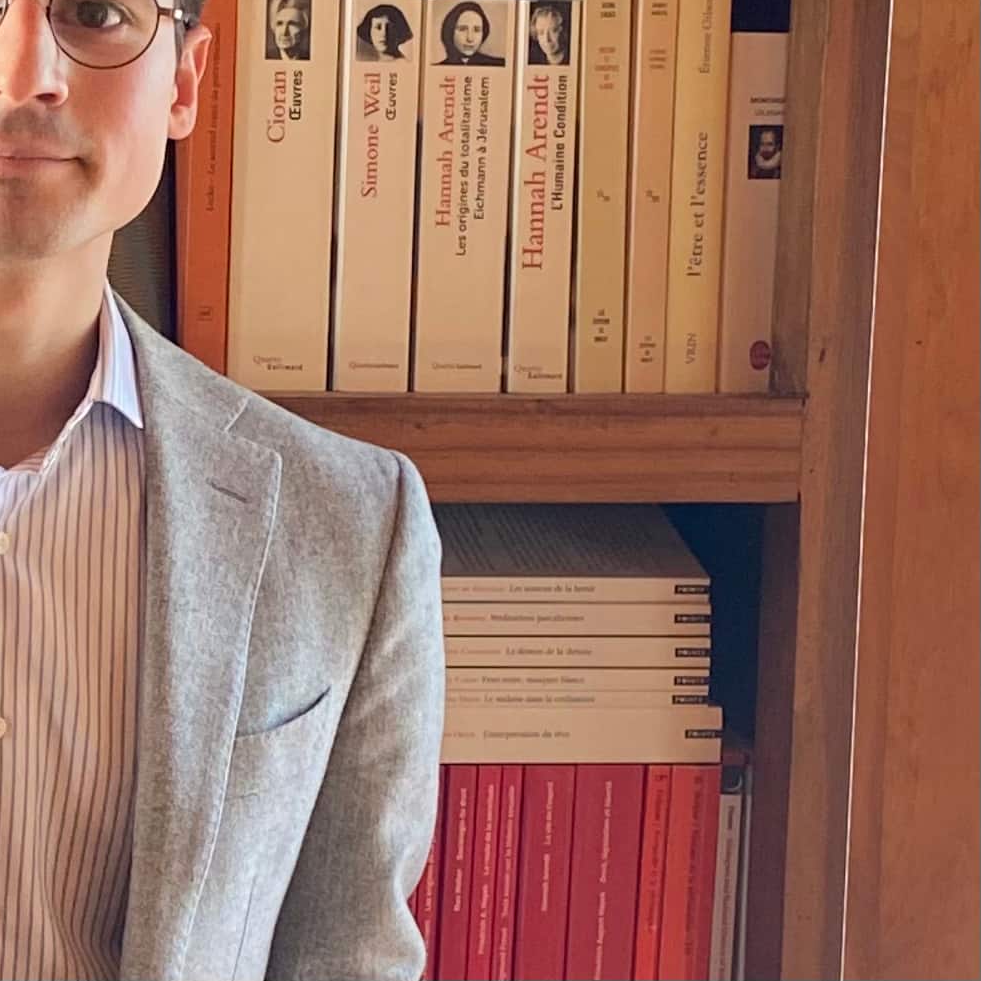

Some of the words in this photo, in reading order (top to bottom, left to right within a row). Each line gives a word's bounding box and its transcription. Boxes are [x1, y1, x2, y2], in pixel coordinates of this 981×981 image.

[266, 70, 287, 144] Cioran
[288, 70, 303, 122] Œuvres
[363, 71, 381, 118] Weil
[385, 72, 398, 122] Œuvres
[437, 75, 456, 144] Arendt
[460, 75, 473, 158] totalitarisme
[476, 75, 490, 143] Jérusalem
[524, 73, 550, 162] Arendt
[553, 74, 568, 139] Condition
[360, 124, 379, 199] Simone
[460, 161, 469, 178] du
[475, 145, 487, 154] à
[550, 142, 566, 212] L'Humaine
[690, 131, 710, 208] l'essence
[434, 150, 453, 227] Hannah
[458, 180, 471, 233] origines
[473, 156, 486, 221] Eichmann
[521, 170, 545, 271] Hannah
[692, 211, 704, 229] et
[455, 234, 467, 257] Les
[685, 232, 702, 279] l'être
[684, 332, 697, 366] VRIN
